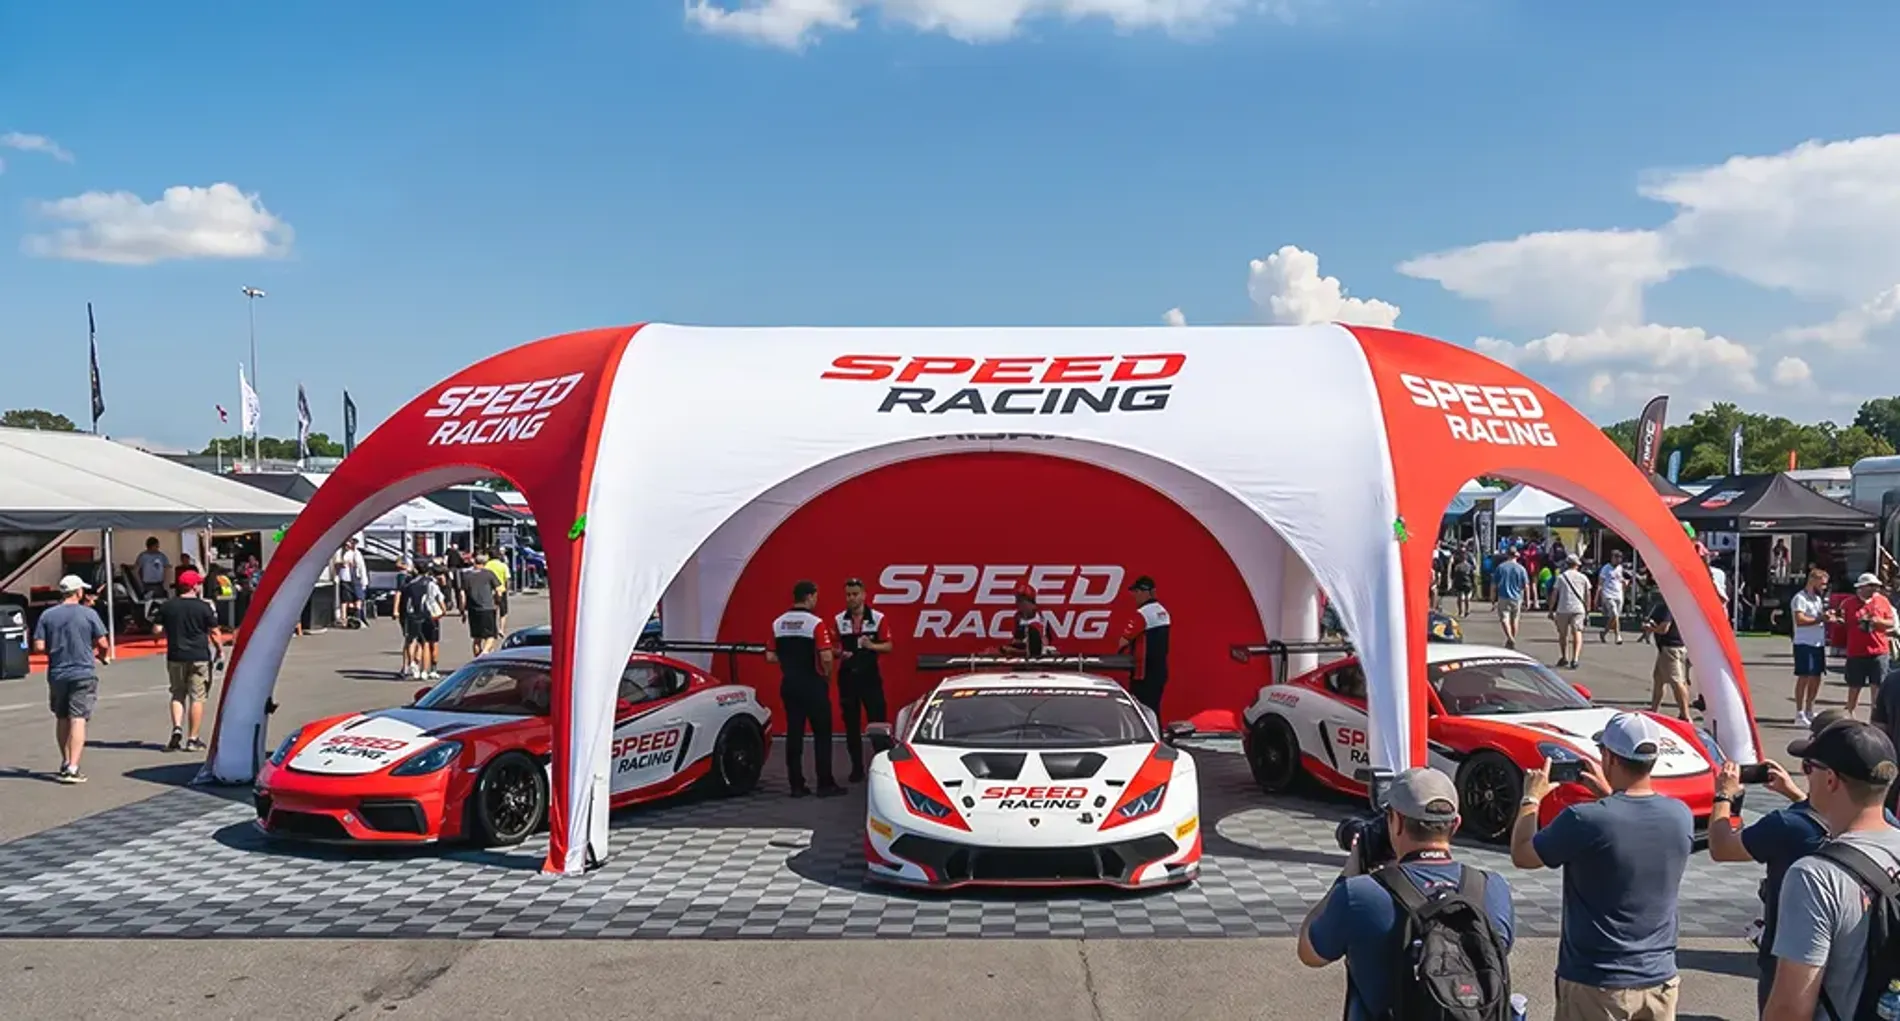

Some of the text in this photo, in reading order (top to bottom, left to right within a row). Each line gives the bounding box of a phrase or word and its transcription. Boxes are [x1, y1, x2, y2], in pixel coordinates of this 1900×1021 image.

[820, 353, 1187, 383] SPEED
[424, 372, 585, 417] SPEED
[877, 384, 1174, 414] RACING
[1400, 373, 1544, 419] SPEED
[427, 412, 550, 445] RACING
[1445, 414, 1558, 447] RACING
[872, 565, 1125, 604] SPEED
[913, 610, 1113, 639] RACNG
[611, 728, 680, 759] SPEED
[617, 749, 674, 774] RACING
[981, 786, 1089, 799] SPEED
[998, 799, 1082, 810] RACING
